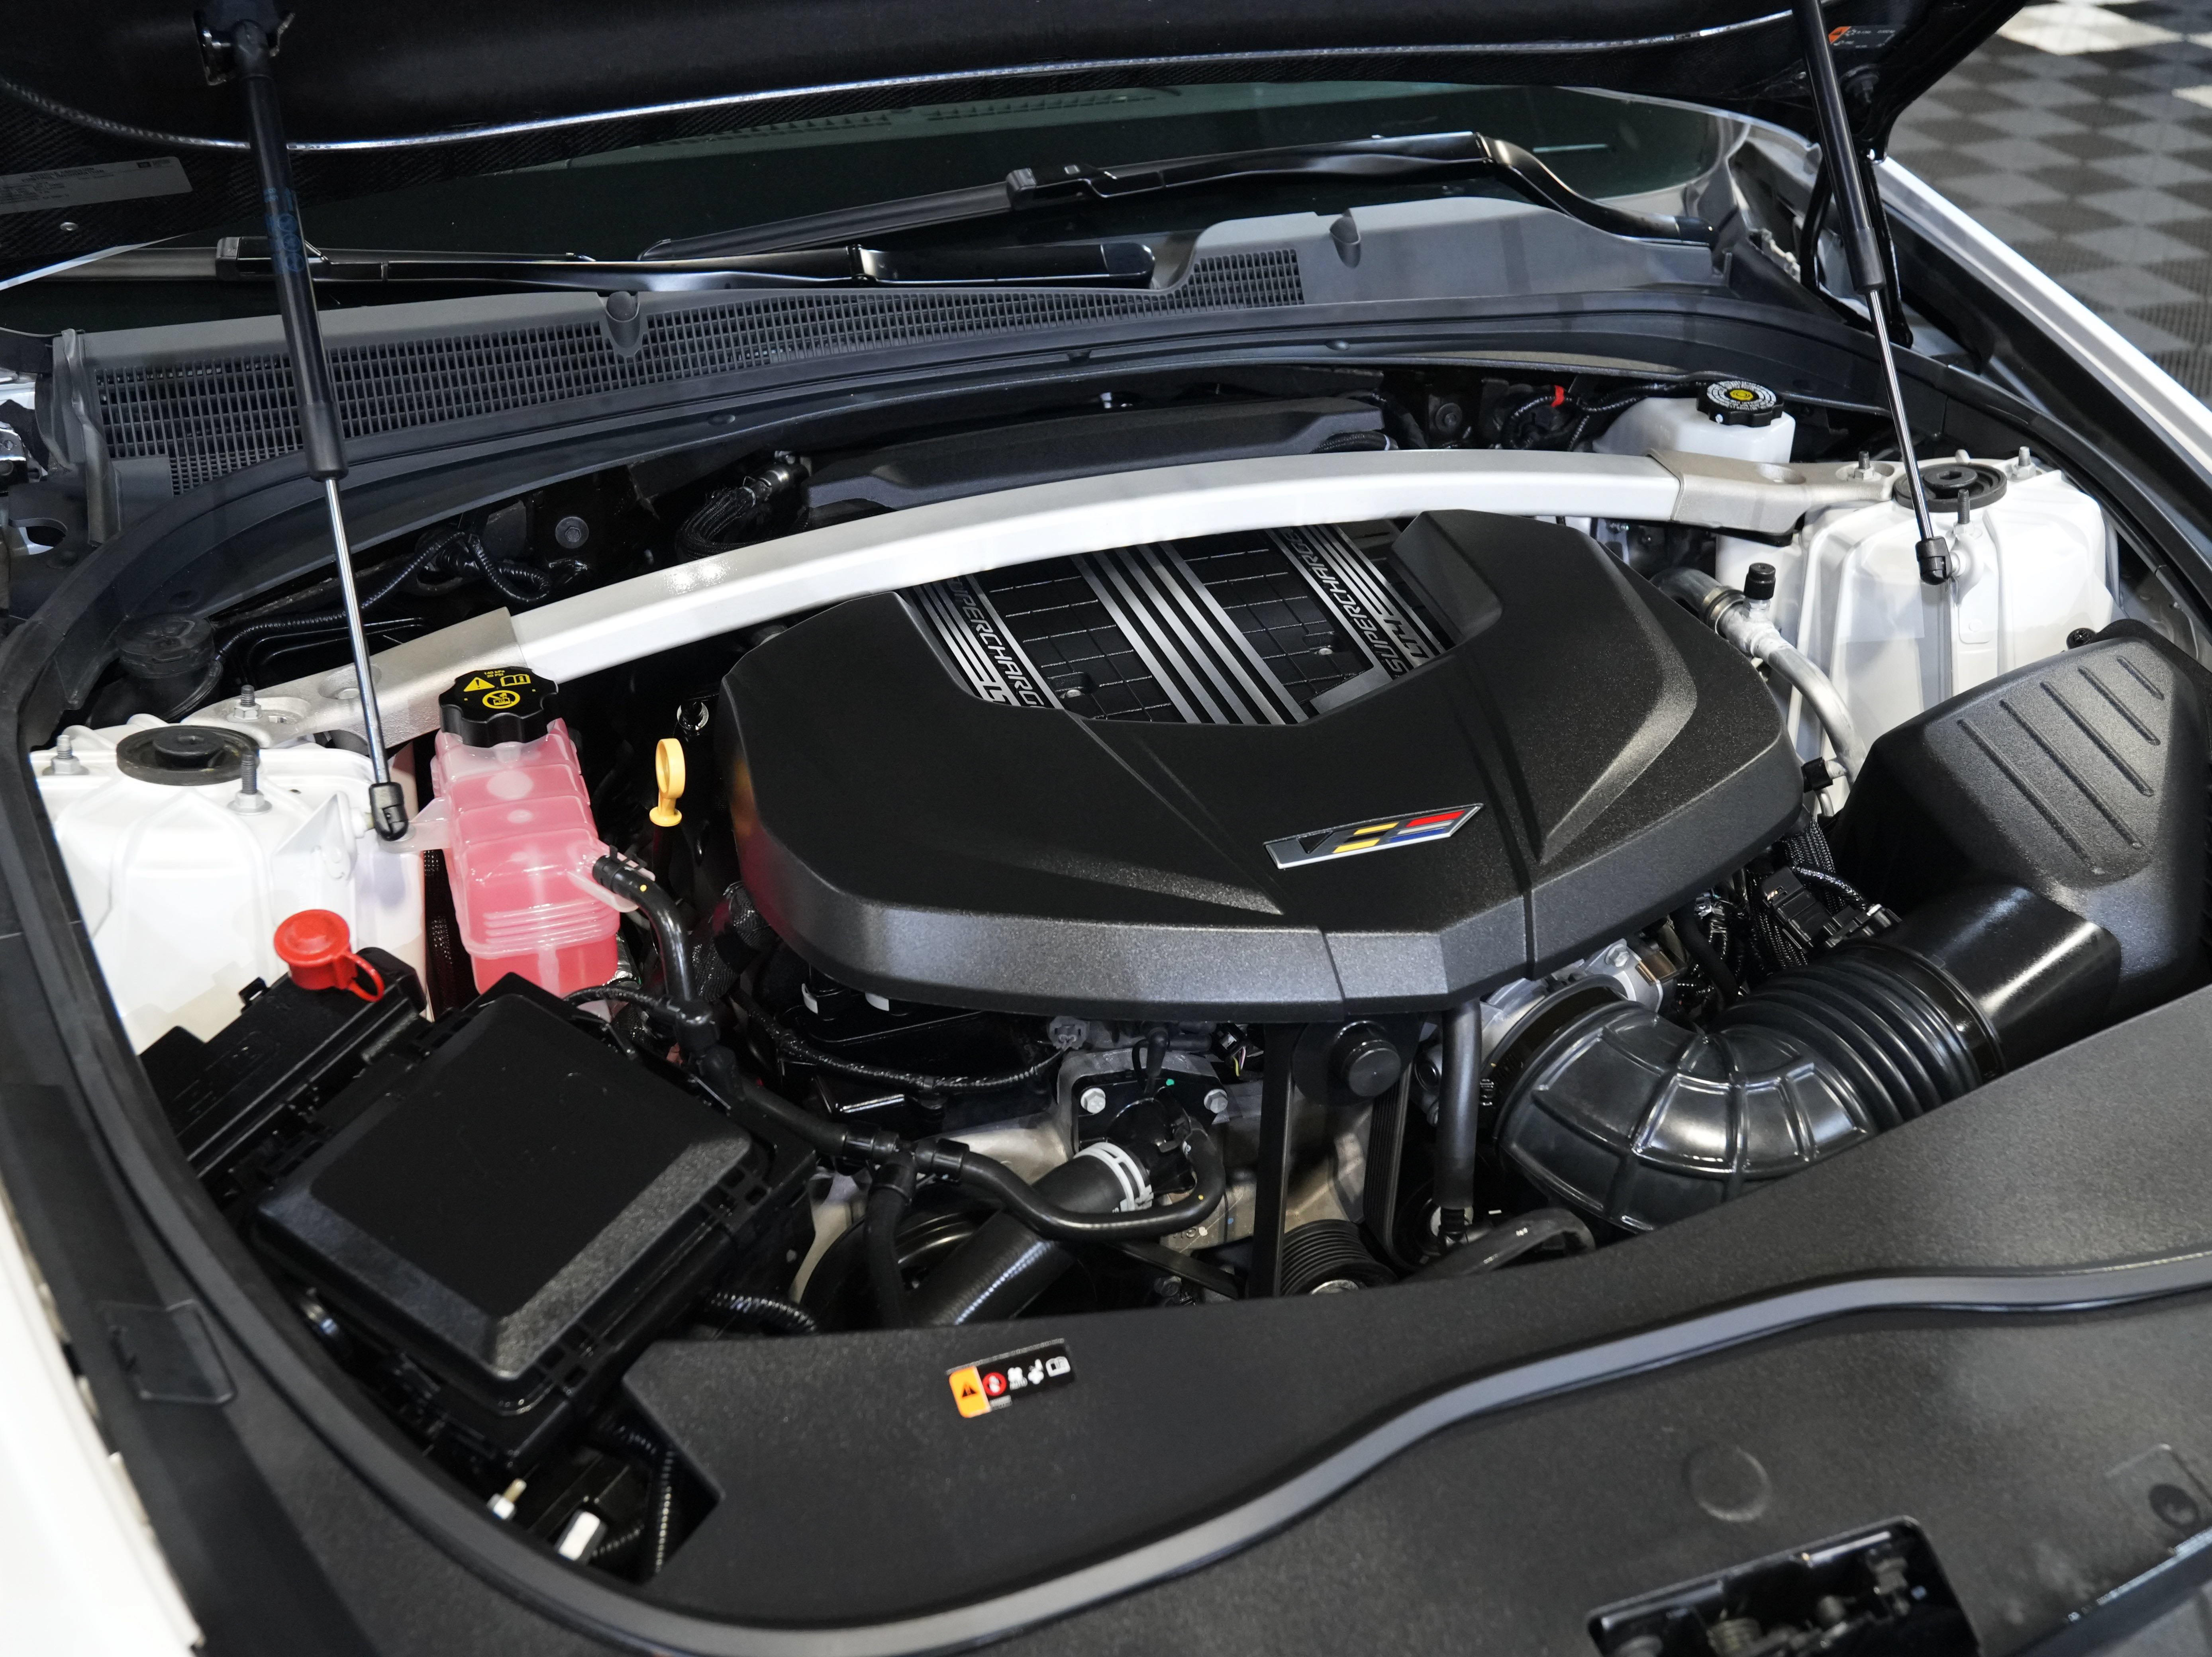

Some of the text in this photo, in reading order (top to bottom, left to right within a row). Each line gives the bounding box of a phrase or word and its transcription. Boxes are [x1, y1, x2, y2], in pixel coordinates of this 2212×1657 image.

[946, 577, 1046, 708] UPERCHARG
[1280, 528, 1407, 673] SUPERCHARGE
[1383, 619, 1429, 658] LT4
